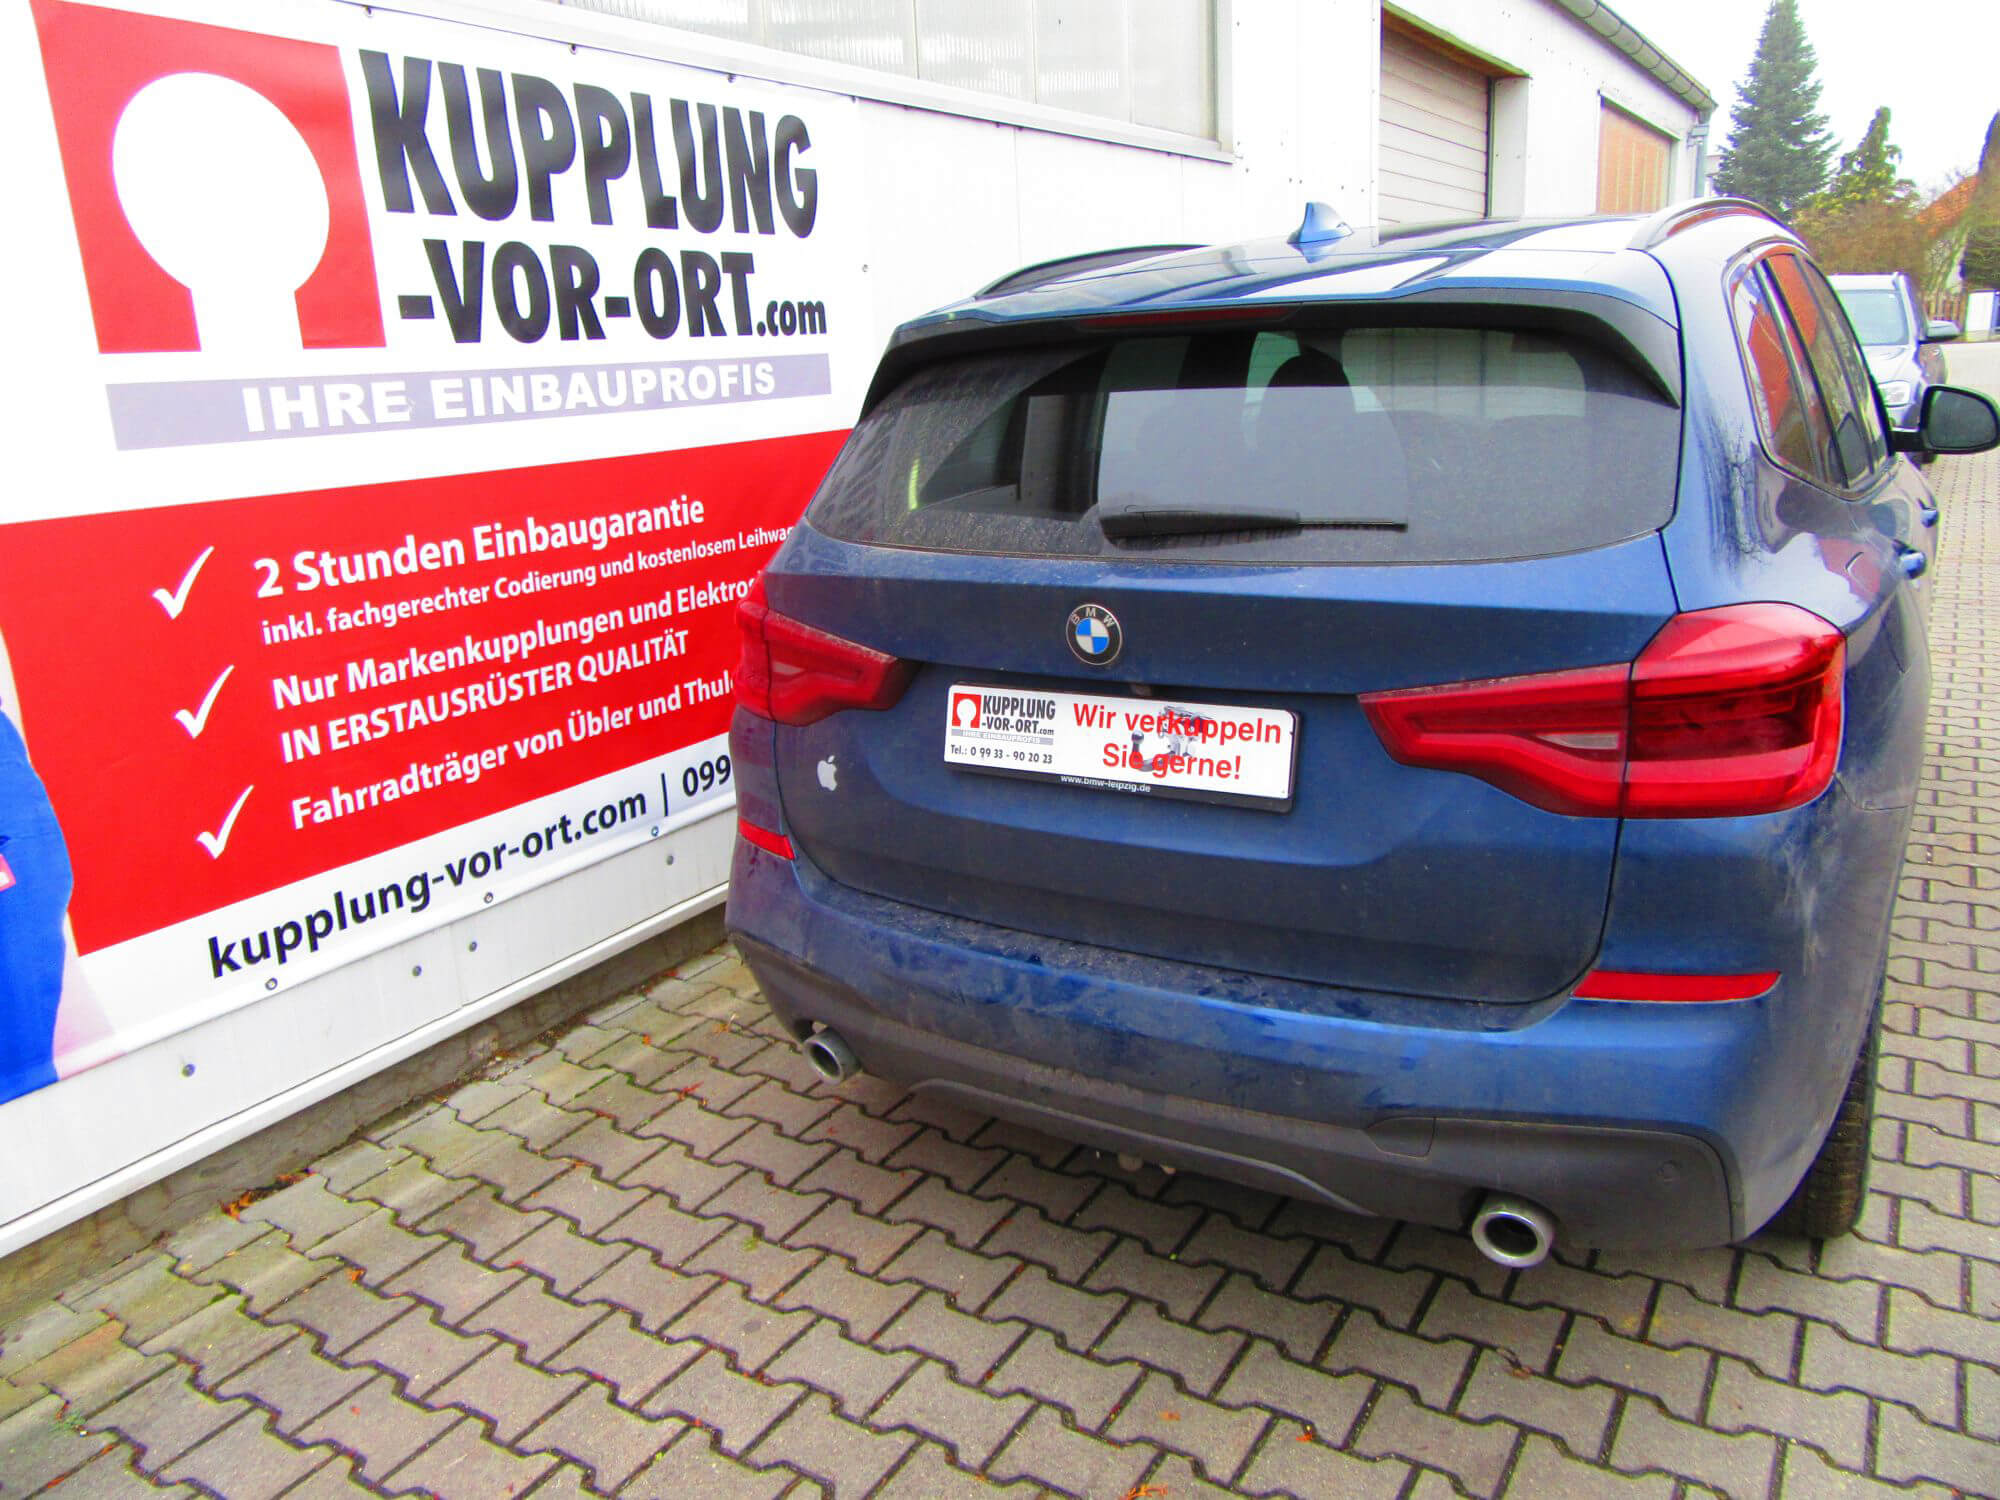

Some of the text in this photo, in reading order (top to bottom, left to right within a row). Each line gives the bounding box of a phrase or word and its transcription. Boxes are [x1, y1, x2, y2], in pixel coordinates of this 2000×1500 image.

[359, 49, 818, 239] KUPPLUNG
[399, 239, 827, 344] -VOR-ORT.com
[243, 361, 776, 433] IHRE EINBAUPROFIS
[254, 494, 705, 598] 2 Stunden Einbaugarantie
[262, 616, 322, 645] inkl.
[327, 586, 489, 633] fachgerechter
[495, 569, 596, 600] Codierung
[601, 556, 634, 581] und
[638, 535, 737, 573] kostenlosem
[272, 577, 756, 708] Nur Markenkupplungen und Elektro
[1071, 607, 1115, 628] BMW
[281, 629, 689, 763] IN ERSTAUSRÜSTER QUALITÄT
[981, 716, 1054, 736] -VOR-ORT.com
[982, 694, 1056, 720] KUPPLUNG
[1073, 703, 1282, 746] Wir verkuppeln
[292, 669, 734, 830] Fahrradträger von Übler und Thul
[1102, 743, 1242, 780] Sie gerne!
[209, 786, 647, 979] kupplung-vor-ort.com
